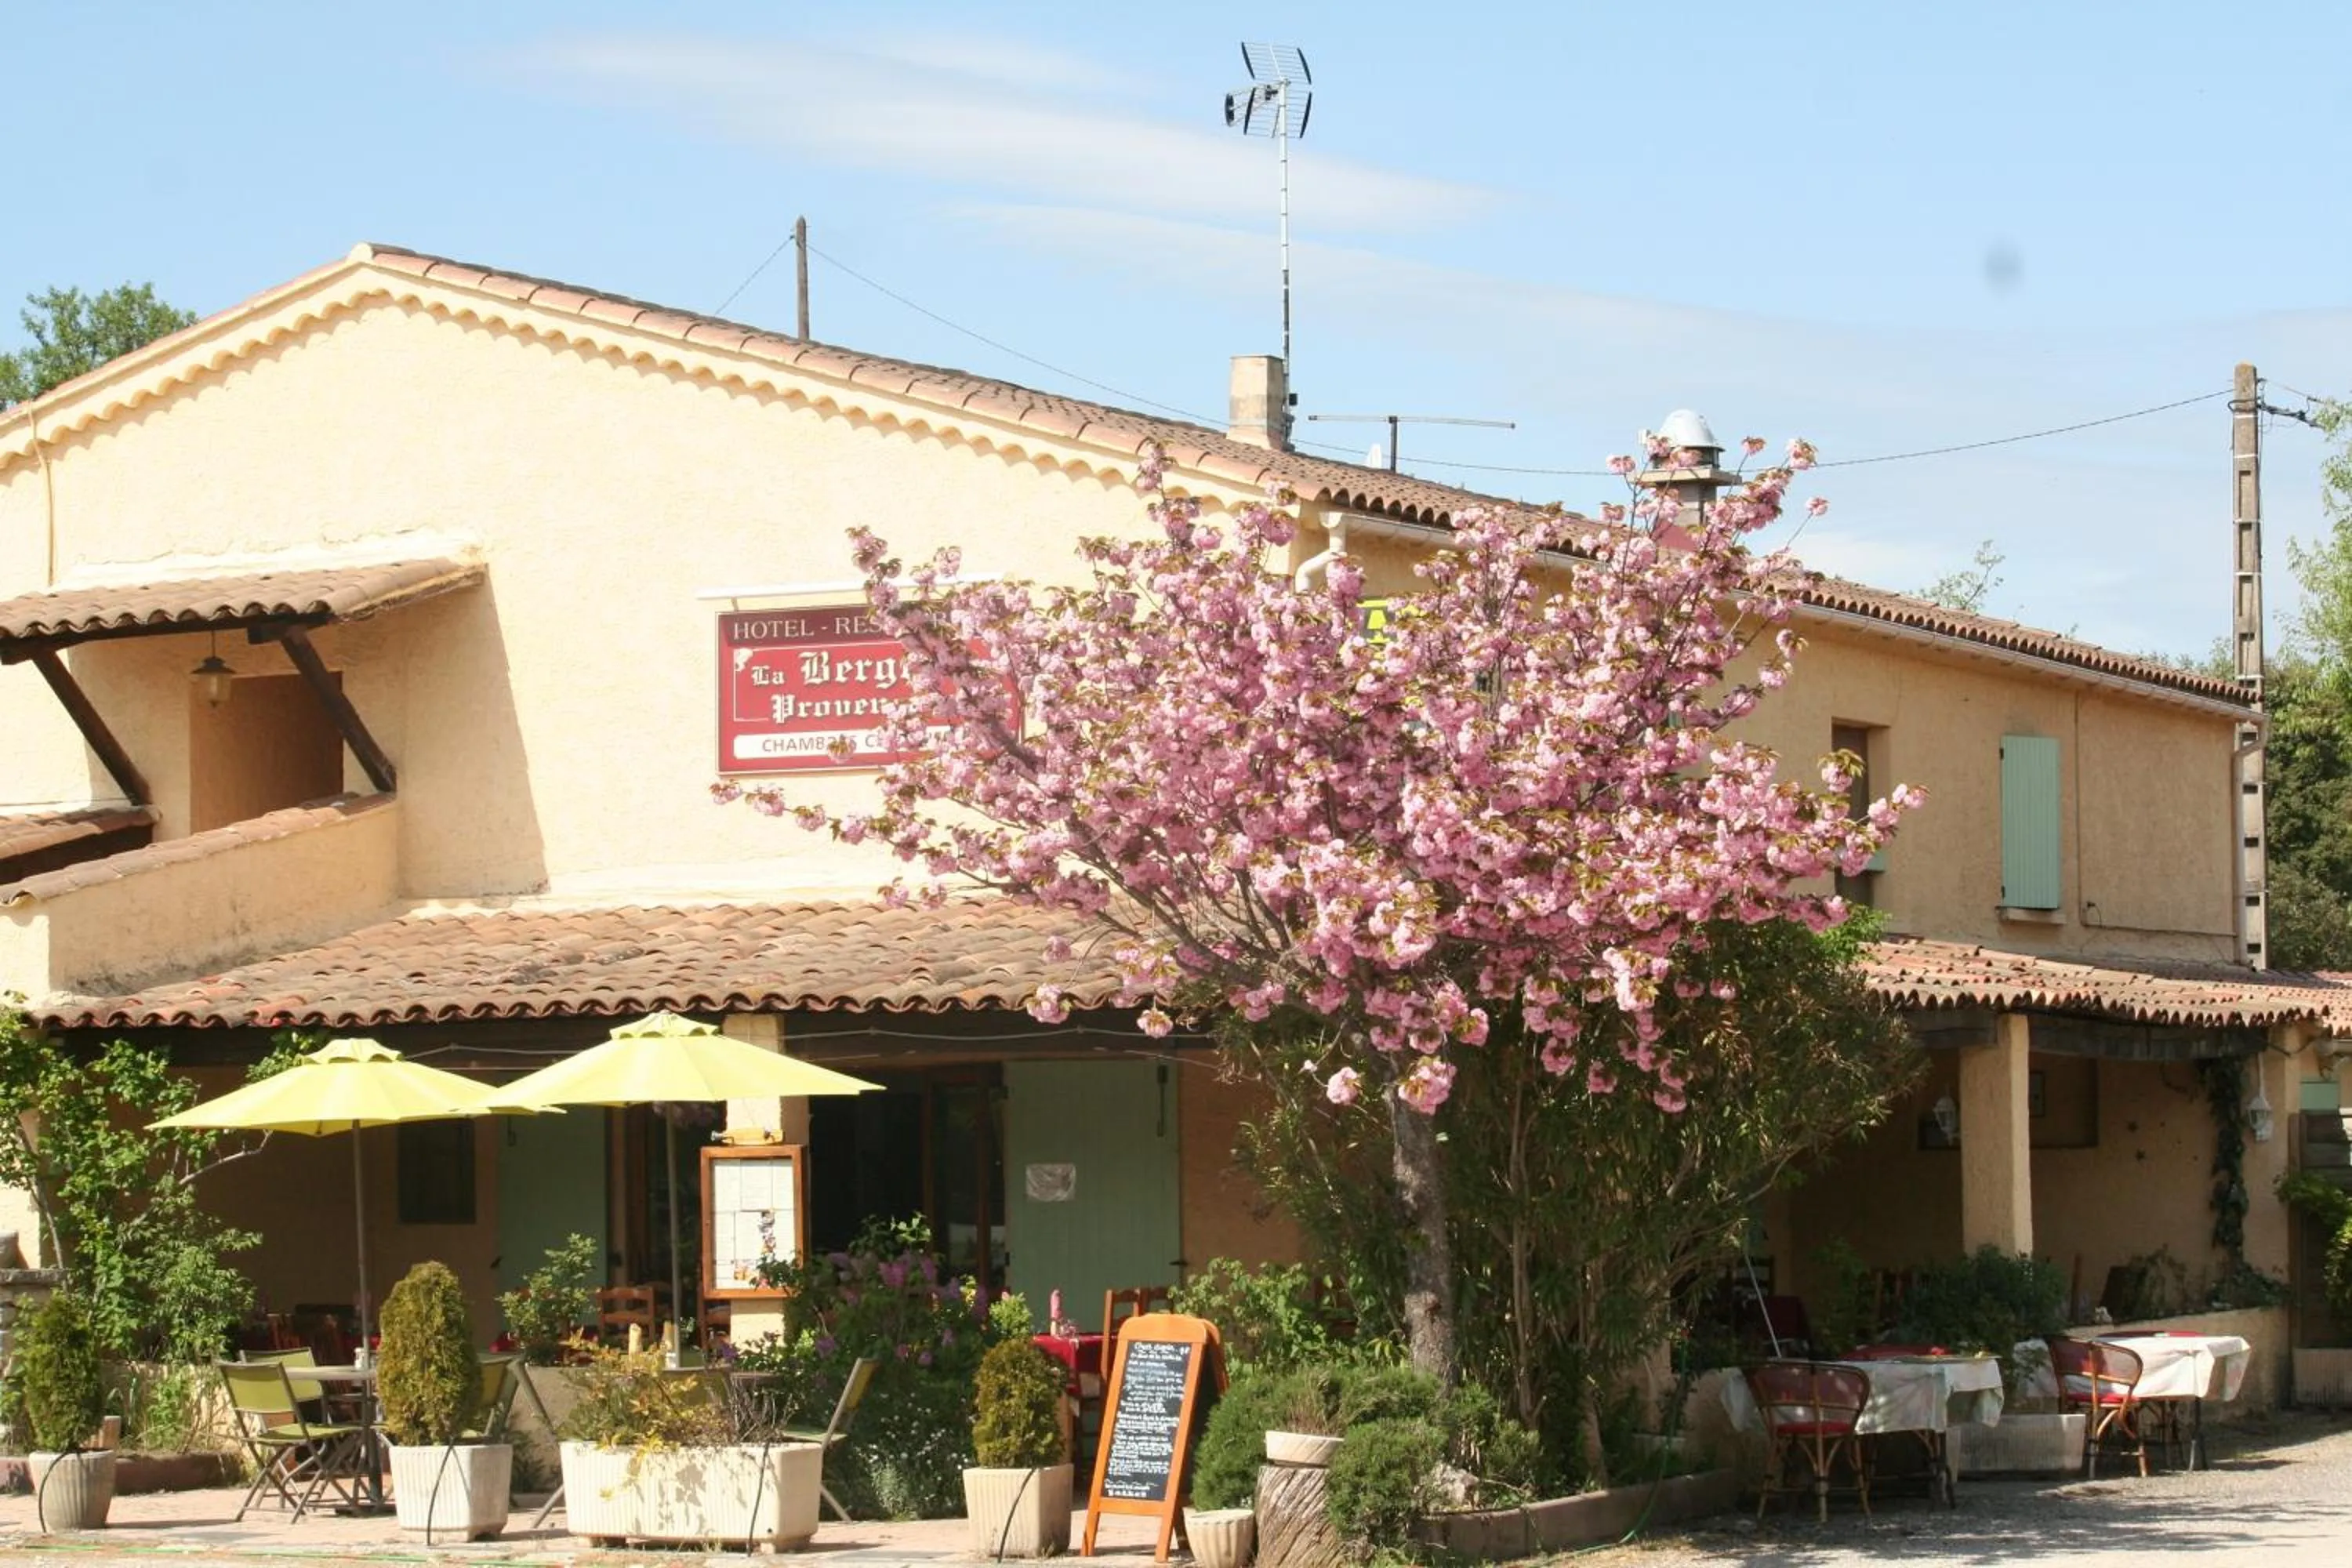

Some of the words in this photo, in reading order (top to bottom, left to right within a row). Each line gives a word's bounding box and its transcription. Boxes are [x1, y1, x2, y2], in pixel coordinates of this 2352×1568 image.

[733, 619, 814, 640] HOTEL
[751, 665, 785, 686] La
[762, 735, 857, 752] CHAMBS
